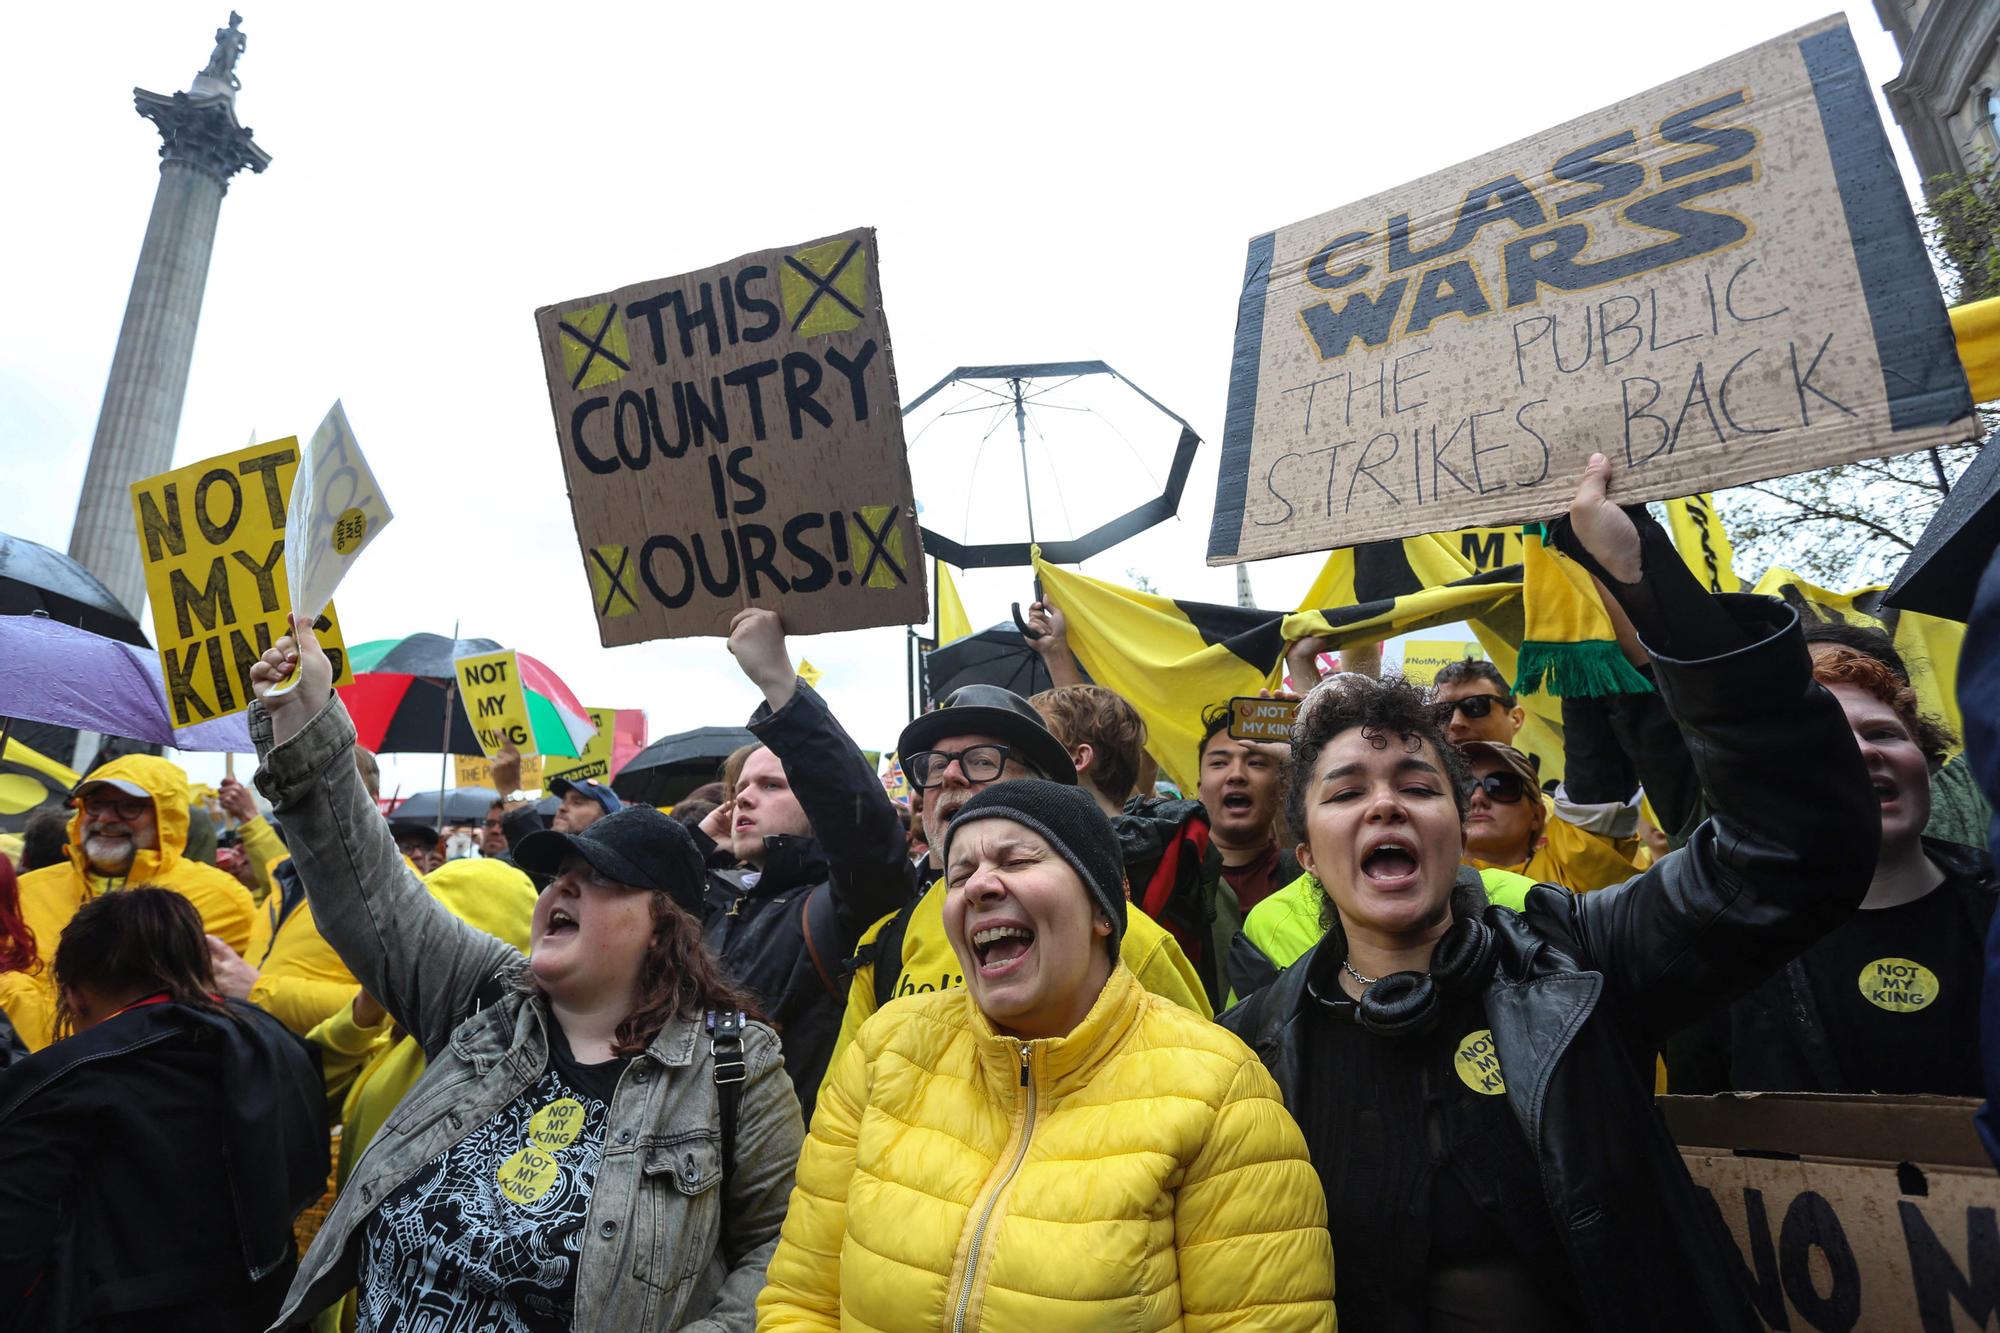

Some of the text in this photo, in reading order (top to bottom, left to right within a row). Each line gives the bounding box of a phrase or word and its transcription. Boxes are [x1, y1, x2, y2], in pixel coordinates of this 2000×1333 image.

[1304, 87, 1763, 293] CLASS
[1297, 159, 1762, 362] WARS
[626, 265, 781, 366] THIS
[1283, 258, 1789, 434] THE PUBLIC
[571, 339, 878, 475] COUNTRY
[1255, 332, 1858, 526] STRIKES BACK
[707, 447, 766, 519] IS
[137, 449, 296, 563] NOT
[335, 519, 346, 550] KING
[346, 522, 354, 539] MY
[354, 514, 363, 539] NOT
[639, 510, 853, 610] OURS!
[1460, 532, 1524, 569] M
[169, 540, 285, 638] MY
[464, 661, 507, 687] NOT
[477, 694, 506, 718] MY
[1257, 705, 1288, 719] NOT
[1242, 721, 1293, 736] MY KIN
[1877, 963, 1920, 979] NOT
[1882, 977, 1914, 991] MY
[1872, 990, 1925, 1005] KING
[1460, 1033, 1494, 1062] NOT
[547, 1105, 577, 1118] NOT
[533, 1130, 570, 1145] KING
[546, 1119, 569, 1131] MY
[520, 1151, 552, 1172] NOT
[514, 1167, 540, 1183] MY
[500, 1177, 536, 1200] KING
